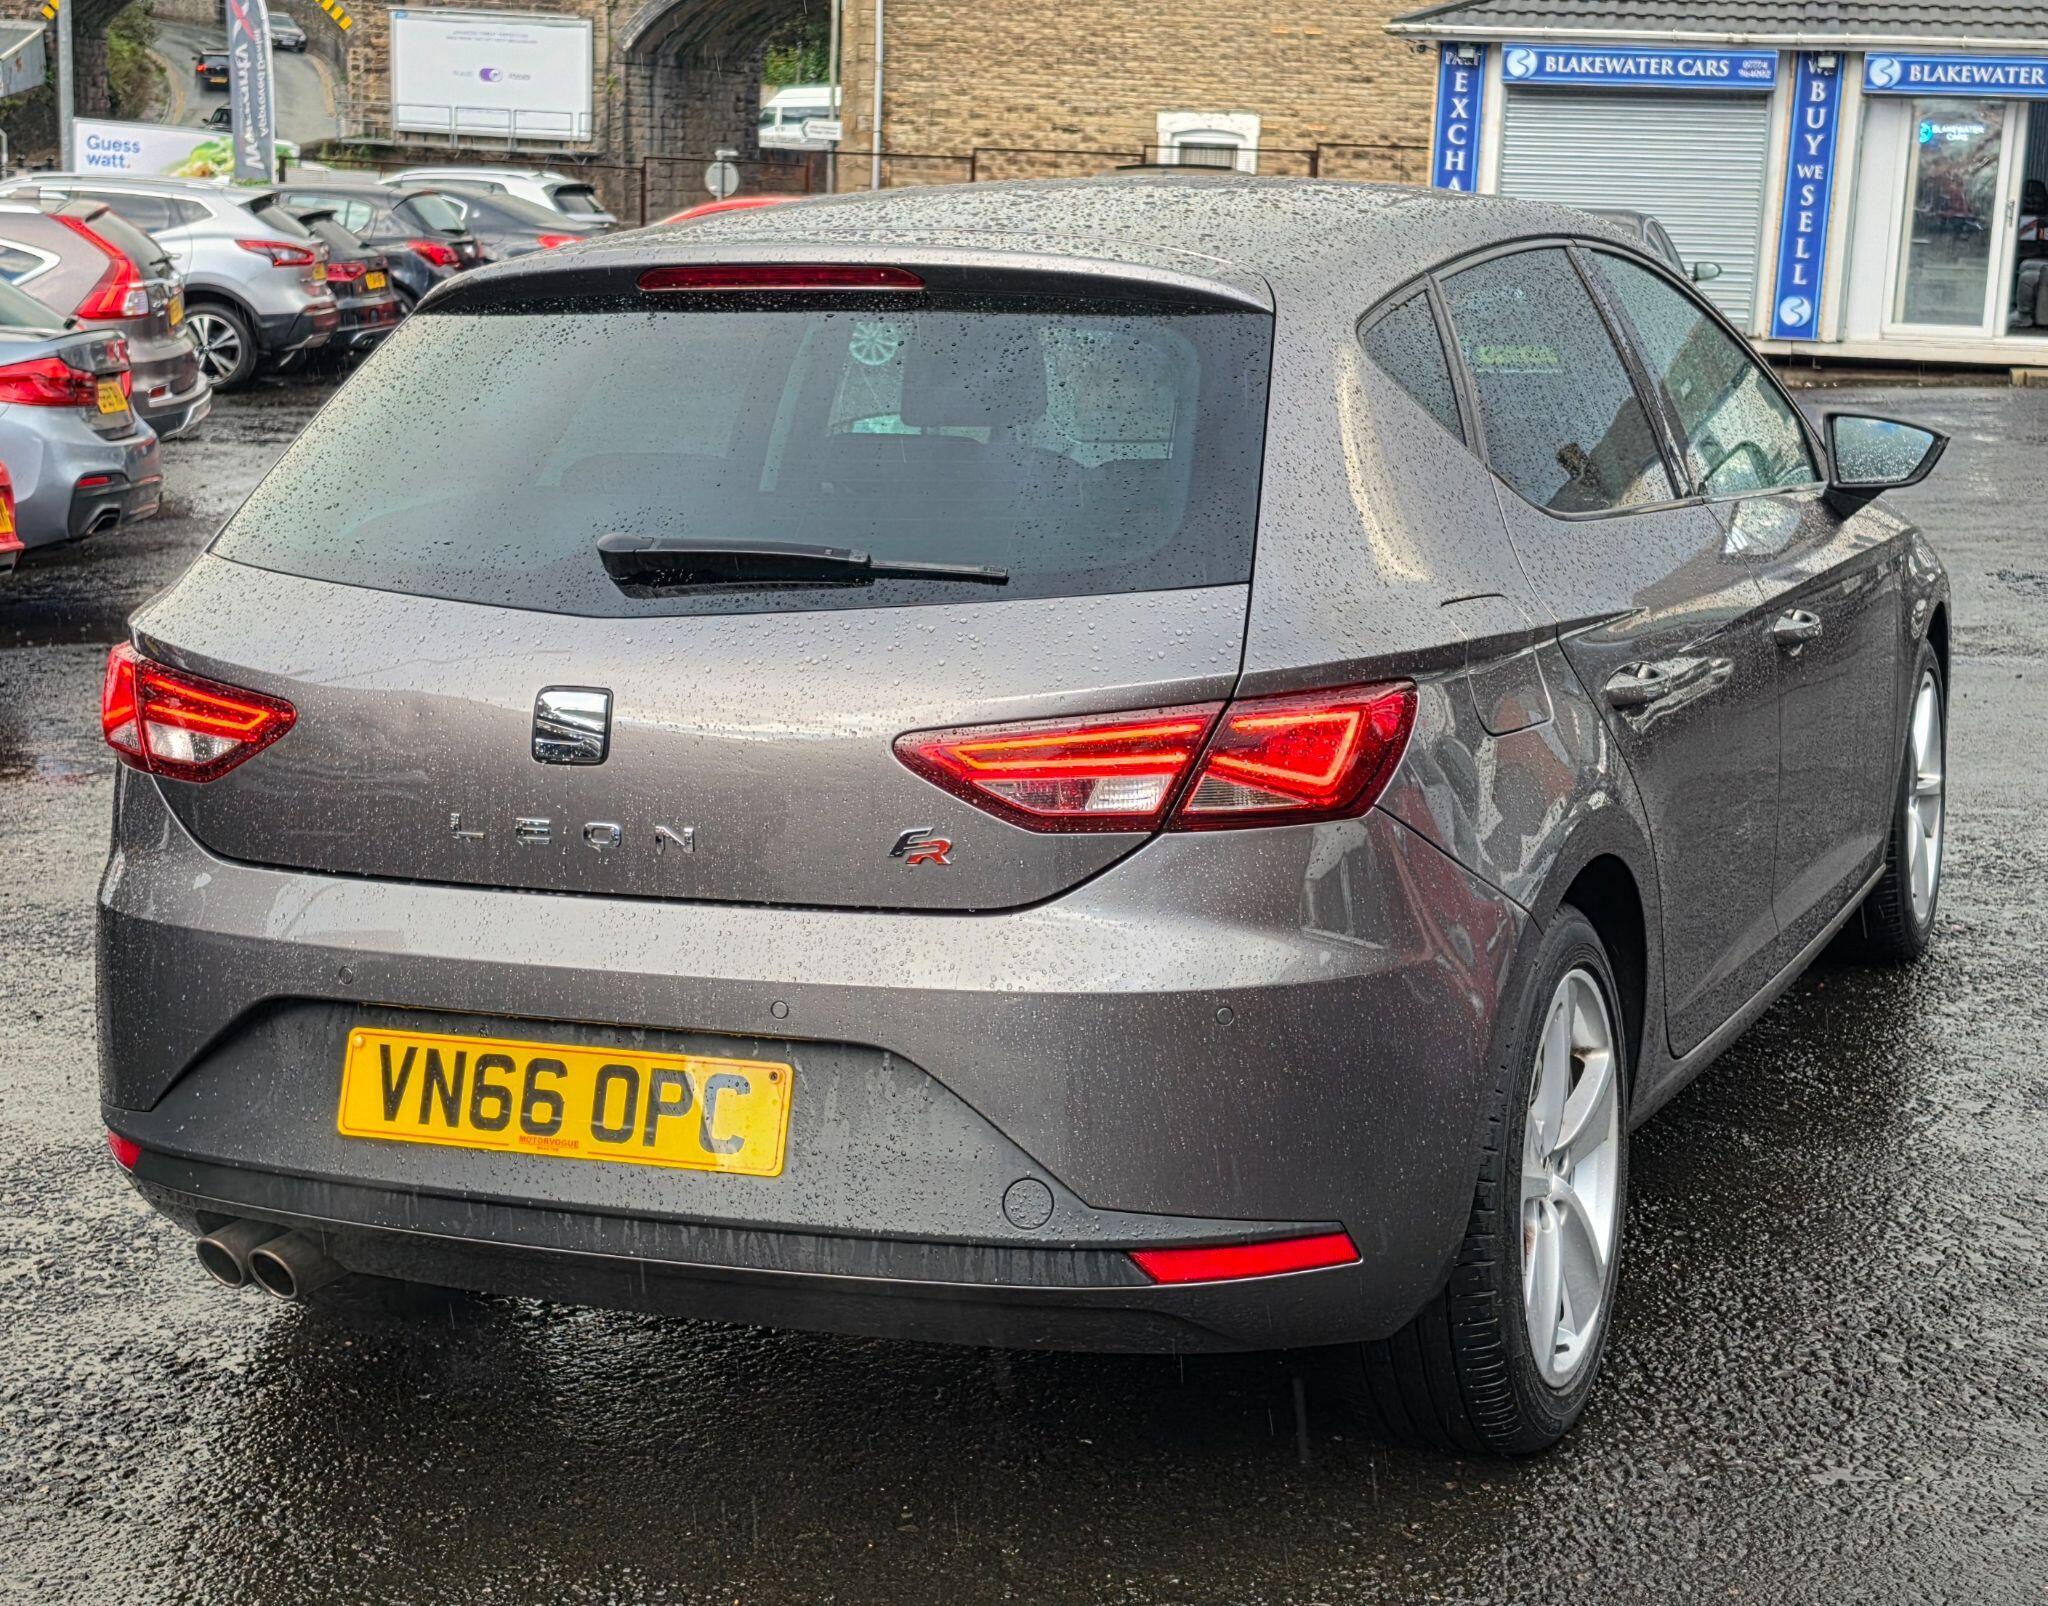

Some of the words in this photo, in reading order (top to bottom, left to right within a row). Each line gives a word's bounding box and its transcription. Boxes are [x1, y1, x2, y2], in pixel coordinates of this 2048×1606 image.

[1545, 56, 1676, 76] BLAKEWATER
[1677, 58, 1730, 77] CARS
[1909, 63, 2046, 85] BLAKEWATER
[1804, 81, 1827, 156] BUY
[86, 134, 141, 153] Guess
[86, 153, 131, 169] watt.
[1797, 163, 1824, 180] WE
[1792, 184, 1815, 285] SELL
[450, 812, 696, 853] LEON
[887, 826, 953, 866] FR
[378, 1043, 569, 1135] VN66
[589, 1063, 751, 1156] OPC
[518, 1135, 580, 1150] MOTORVOGUE
